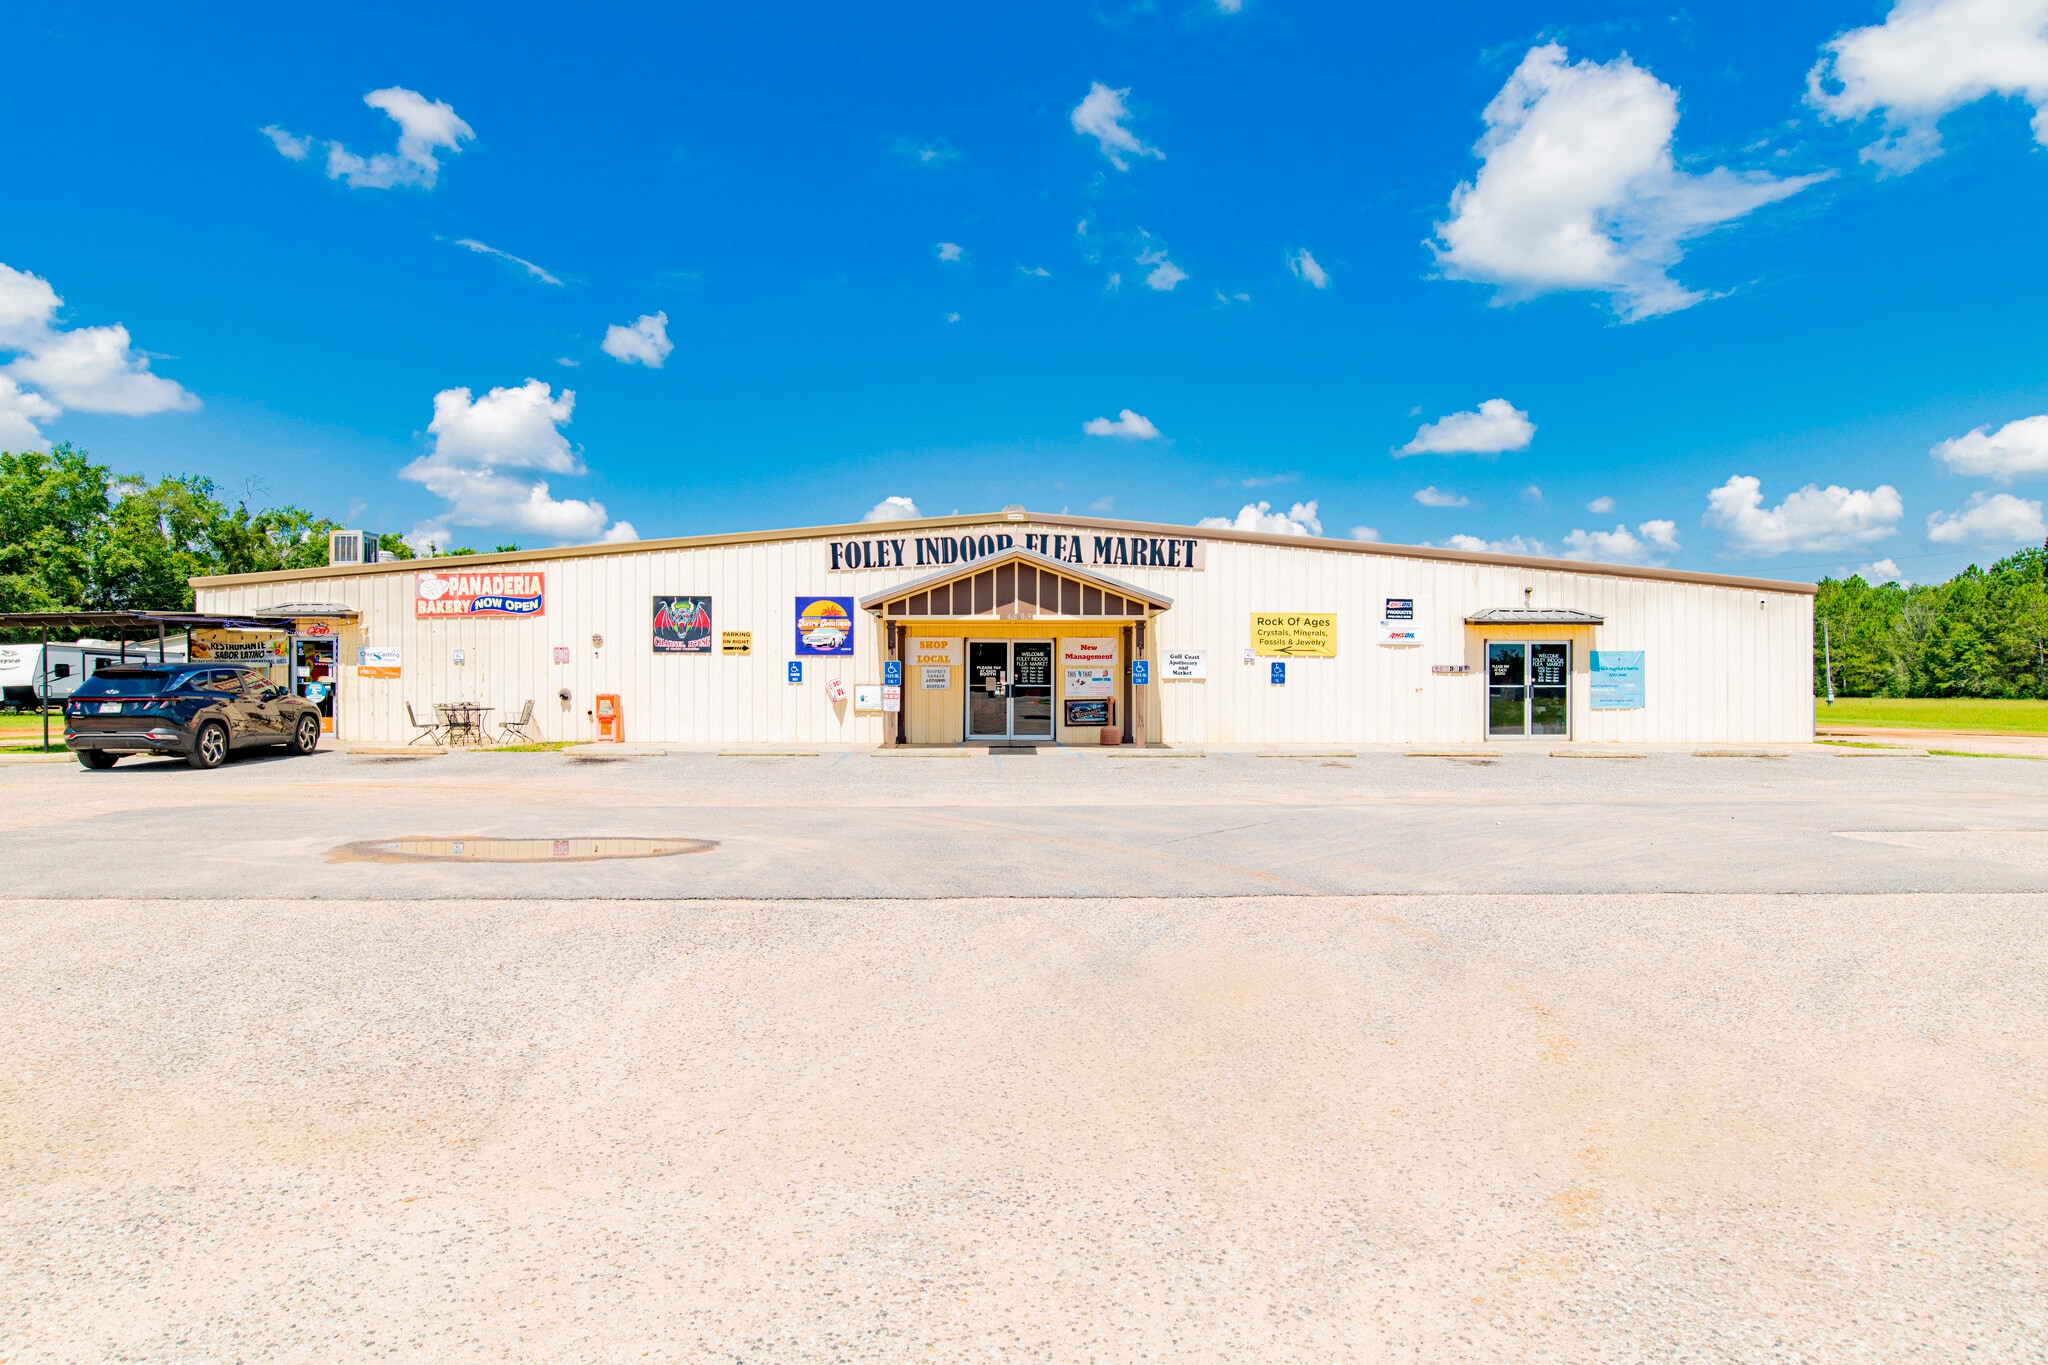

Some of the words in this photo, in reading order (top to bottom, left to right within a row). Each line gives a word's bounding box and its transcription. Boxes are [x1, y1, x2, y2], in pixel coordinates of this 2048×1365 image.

[830, 538, 906, 570] FOLEY
[1093, 536, 1197, 568] MARKET
[448, 576, 542, 596] PANADERIA
[418, 600, 470, 614] BAKERY
[475, 598, 502, 610] NOW
[505, 599, 538, 611] OPEN
[1257, 617, 1284, 626] Rock
[1287, 617, 1300, 626] Of
[1304, 618, 1330, 628] Ages
[214, 651, 238, 659] SABOR
